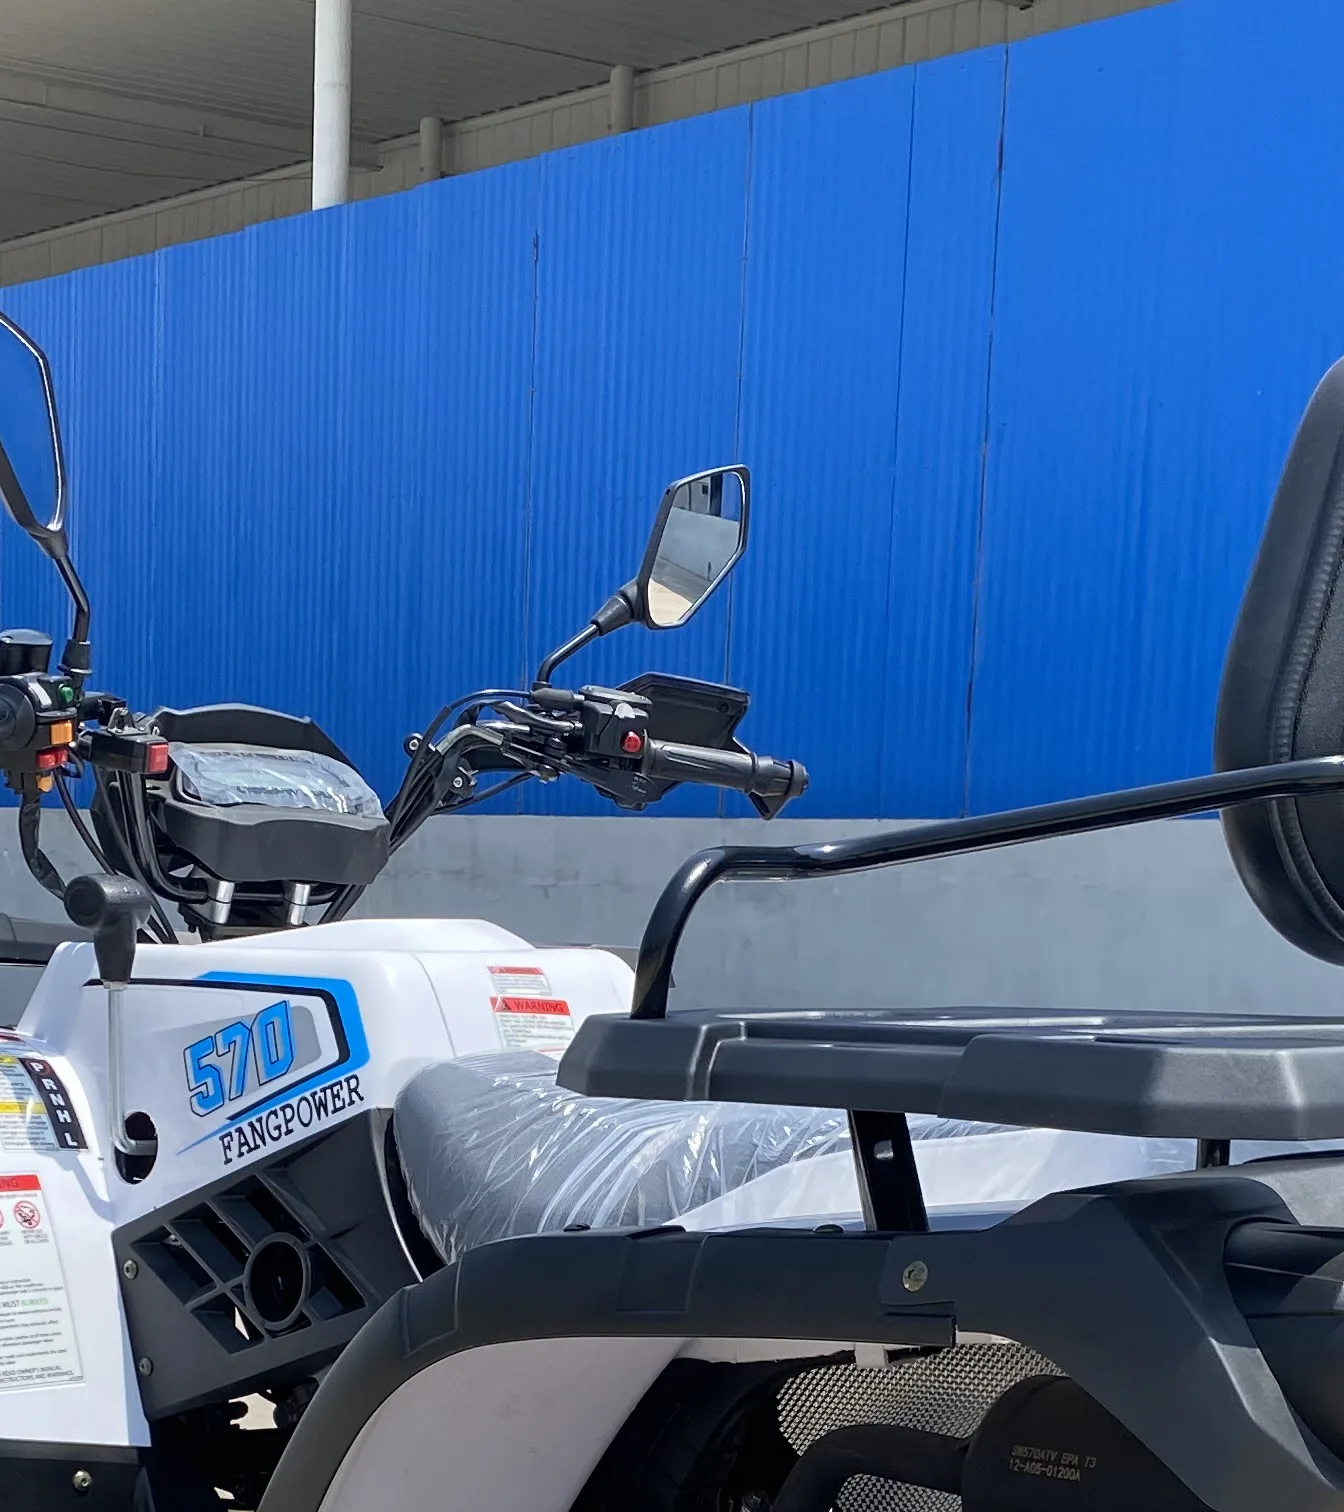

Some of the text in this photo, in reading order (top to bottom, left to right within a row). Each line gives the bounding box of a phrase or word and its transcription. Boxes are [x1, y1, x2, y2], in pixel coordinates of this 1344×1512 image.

[183, 1000, 295, 1117] 570
[218, 1073, 365, 1165] FANGPOWER
[2, 1299, 20, 1308] MUST
[1061, 1453, 1079, 1465] EPA
